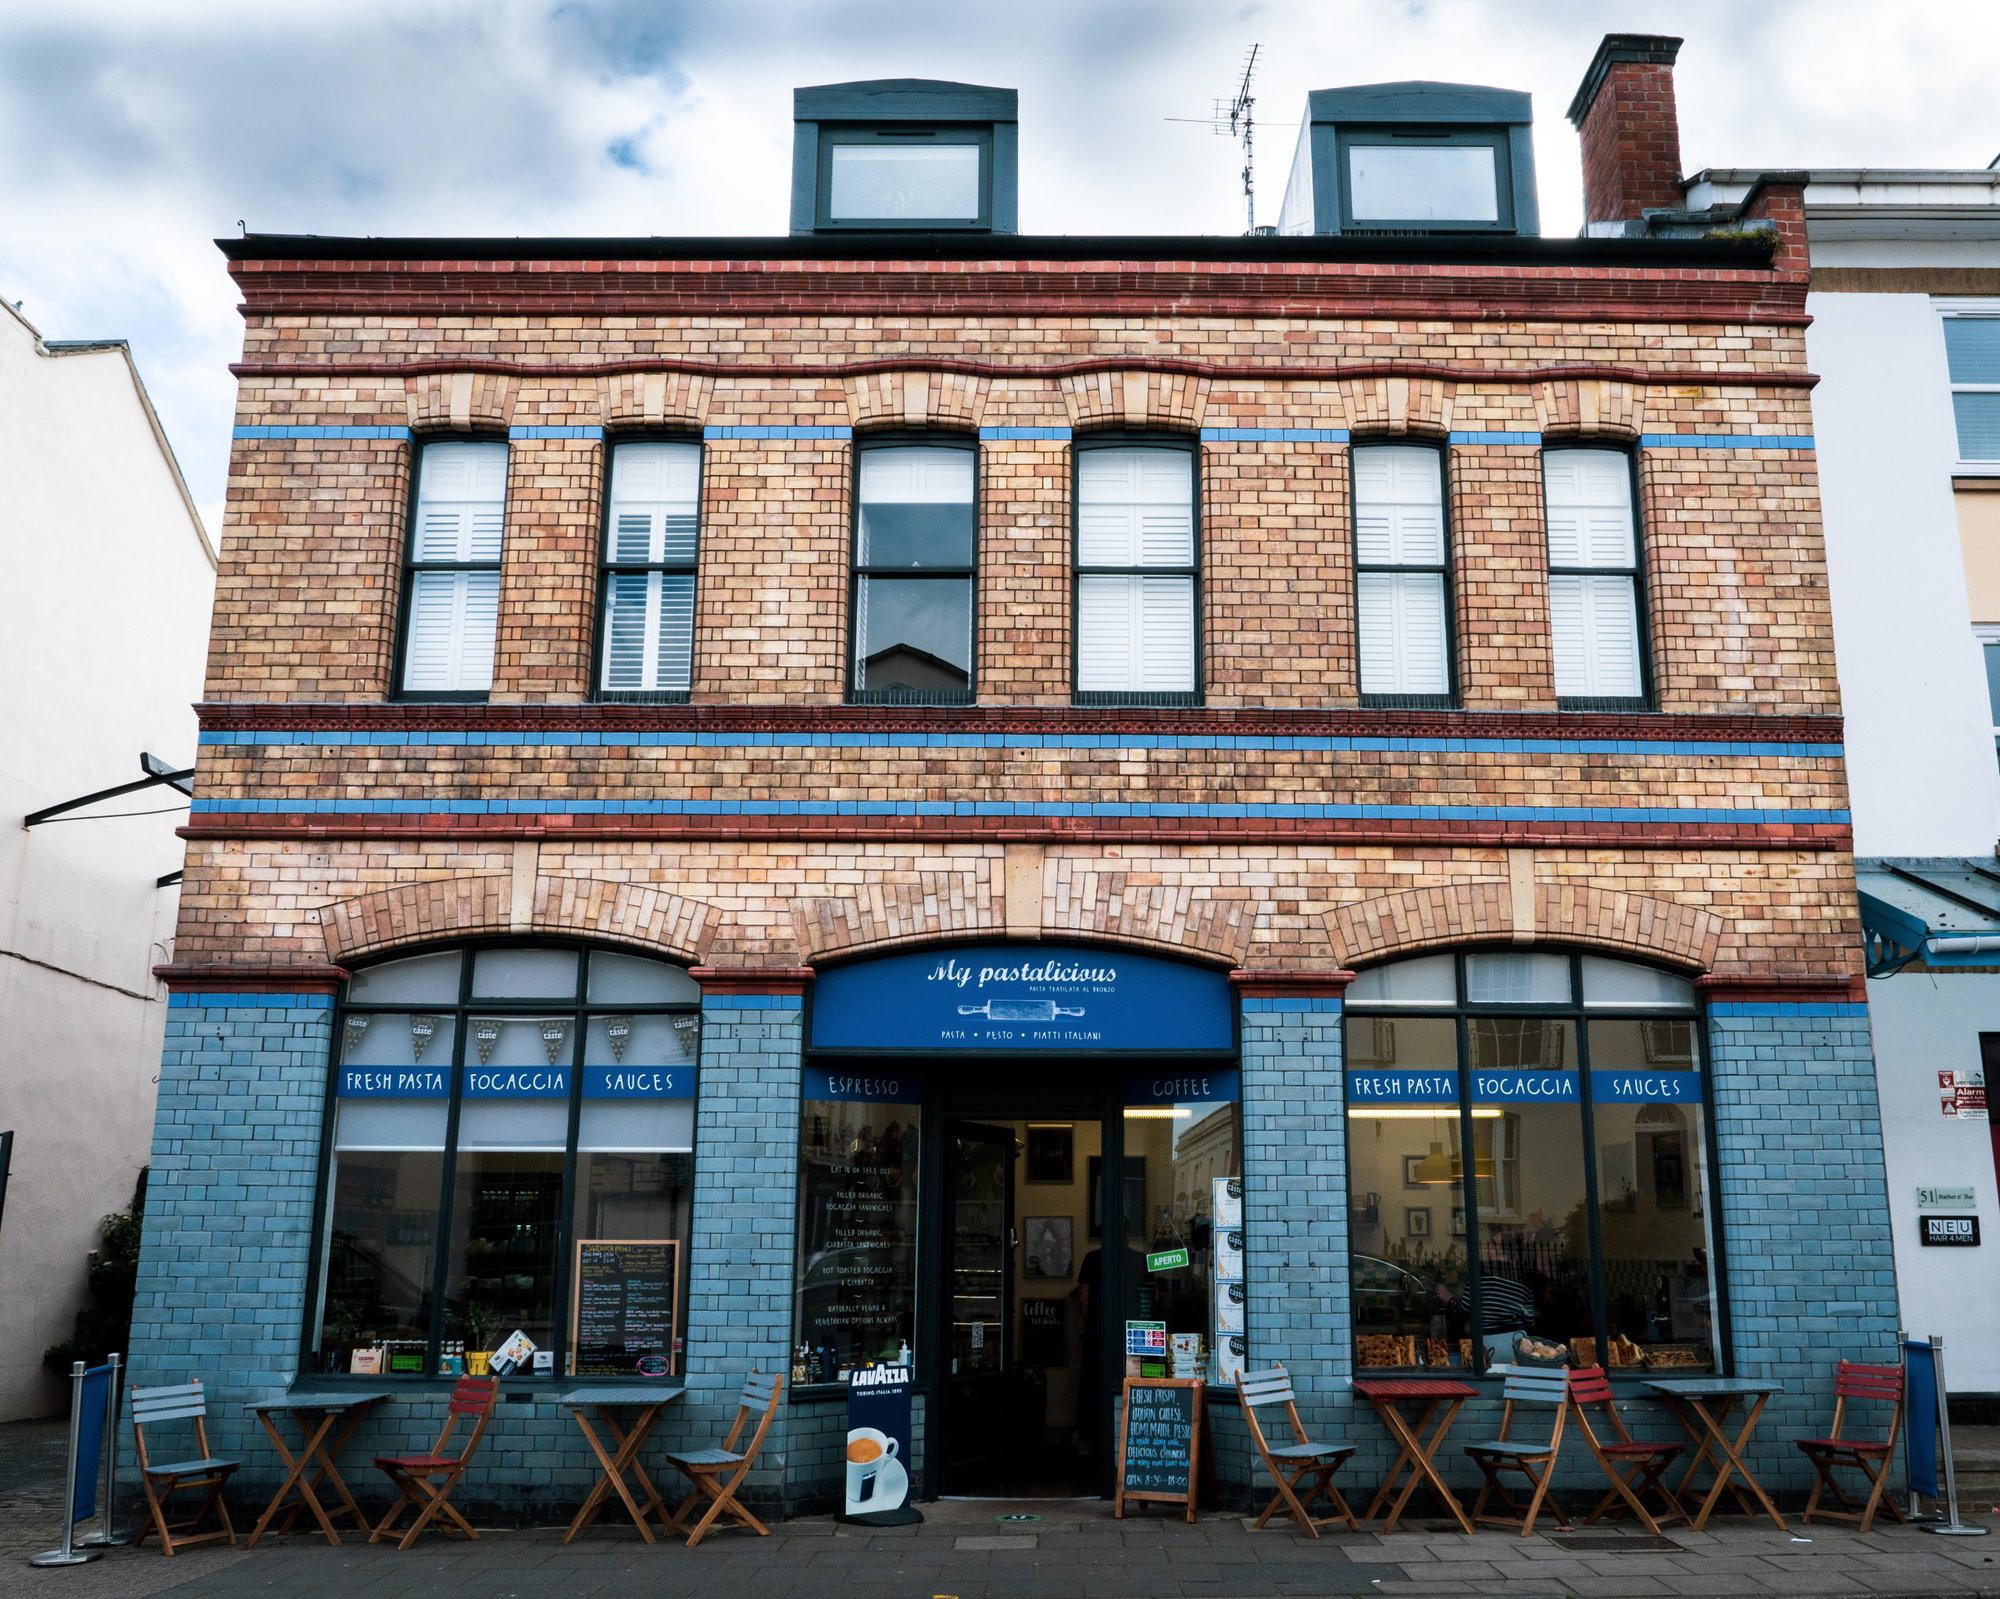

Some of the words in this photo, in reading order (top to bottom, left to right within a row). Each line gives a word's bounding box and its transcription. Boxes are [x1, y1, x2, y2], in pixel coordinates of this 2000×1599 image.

[928, 958, 973, 988] My
[978, 960, 1117, 988] pastalicious
[348, 1019, 368, 1028] taste
[674, 1020, 694, 1029] taste
[412, 1027, 432, 1036] taste
[477, 1031, 497, 1040] taste
[543, 1032, 563, 1040] taste
[608, 1028, 629, 1036] taste
[941, 1030, 965, 1040] PASTA
[986, 1031, 1013, 1040] PESTO
[1033, 1031, 1060, 1040] PIATTI
[1064, 1031, 1101, 1041] ITALIANI
[346, 1073, 392, 1091] FRESH
[398, 1073, 443, 1091] PASTA
[470, 1073, 565, 1091] FOCACCIA
[605, 1073, 673, 1092] SAUCES
[828, 1076, 899, 1096] ESPRESSO
[1152, 1078, 1211, 1097] COFFEE
[1355, 1077, 1401, 1095] FRESH
[1407, 1078, 1452, 1095] PASTA
[1478, 1077, 1573, 1095] FOCACCIA
[1613, 1078, 1681, 1097] SAUCES
[1957, 1088, 1984, 1096] Alarm
[836, 1191, 856, 1199] FILLED
[1920, 1190, 1934, 1203] 51
[826, 1202, 857, 1211] FOCACCIA
[858, 1204, 892, 1212] SANDWICHES
[857, 1229, 883, 1237] ORGANIC
[1931, 1222, 1970, 1233] NEU
[856, 1241, 890, 1249] SANDWICHES
[1153, 1254, 1183, 1267] APERTO
[828, 1304, 860, 1312] NATURALLY
[1024, 1301, 1057, 1316] Coffee
[814, 1317, 850, 1326] VEGETARIAN
[851, 1317, 874, 1325] OPTIONS
[851, 1364, 910, 1387] LAVAZZA
[1130, 1388, 1152, 1404] FRESH
[1132, 1406, 1156, 1422] ITALIAN
[1158, 1407, 1182, 1422] CHEESE
[1128, 1446, 1158, 1458] DELICIOUS
[1126, 1474, 1142, 1486] OPEN
